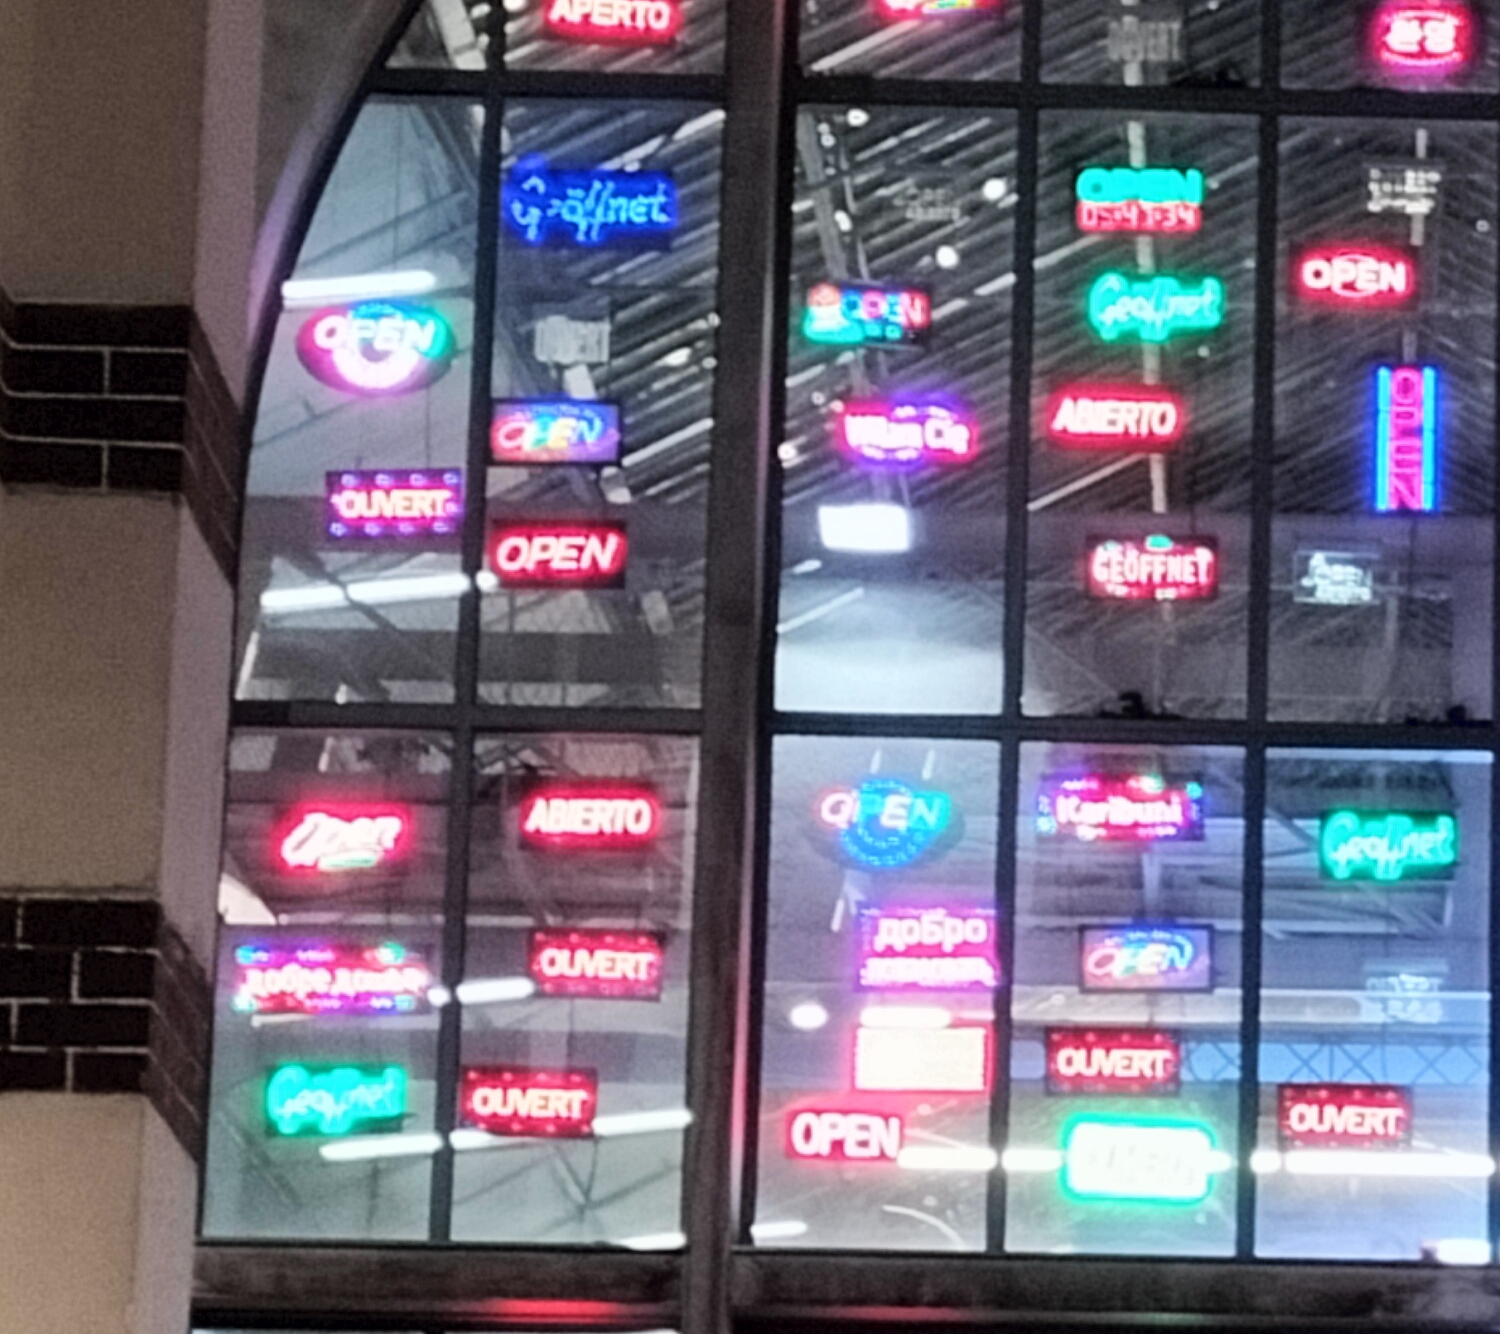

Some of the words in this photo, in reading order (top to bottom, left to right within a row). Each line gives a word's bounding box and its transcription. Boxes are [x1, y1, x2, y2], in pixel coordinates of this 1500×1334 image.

[1077, 168, 1204, 204] OPEN
[1302, 259, 1408, 293] OPEN
[312, 313, 436, 353] OPEN
[498, 415, 602, 450] OPEN
[1052, 397, 1177, 435] ABIERTO
[1391, 369, 1423, 510] OPEN
[337, 489, 449, 519] OUVERT
[495, 535, 620, 571] OPEN
[1092, 543, 1212, 586] GEÖFFNET
[524, 798, 652, 836] ABIERTO
[820, 791, 940, 830] OPEN
[282, 811, 401, 867] Open
[539, 948, 654, 981] OUVERT
[1088, 941, 1193, 977] OPEN
[1056, 1046, 1175, 1080] OUVERT
[471, 1087, 588, 1120] OUVERT
[1289, 1106, 1406, 1135] OUVERT
[791, 1112, 901, 1159] OPEN
